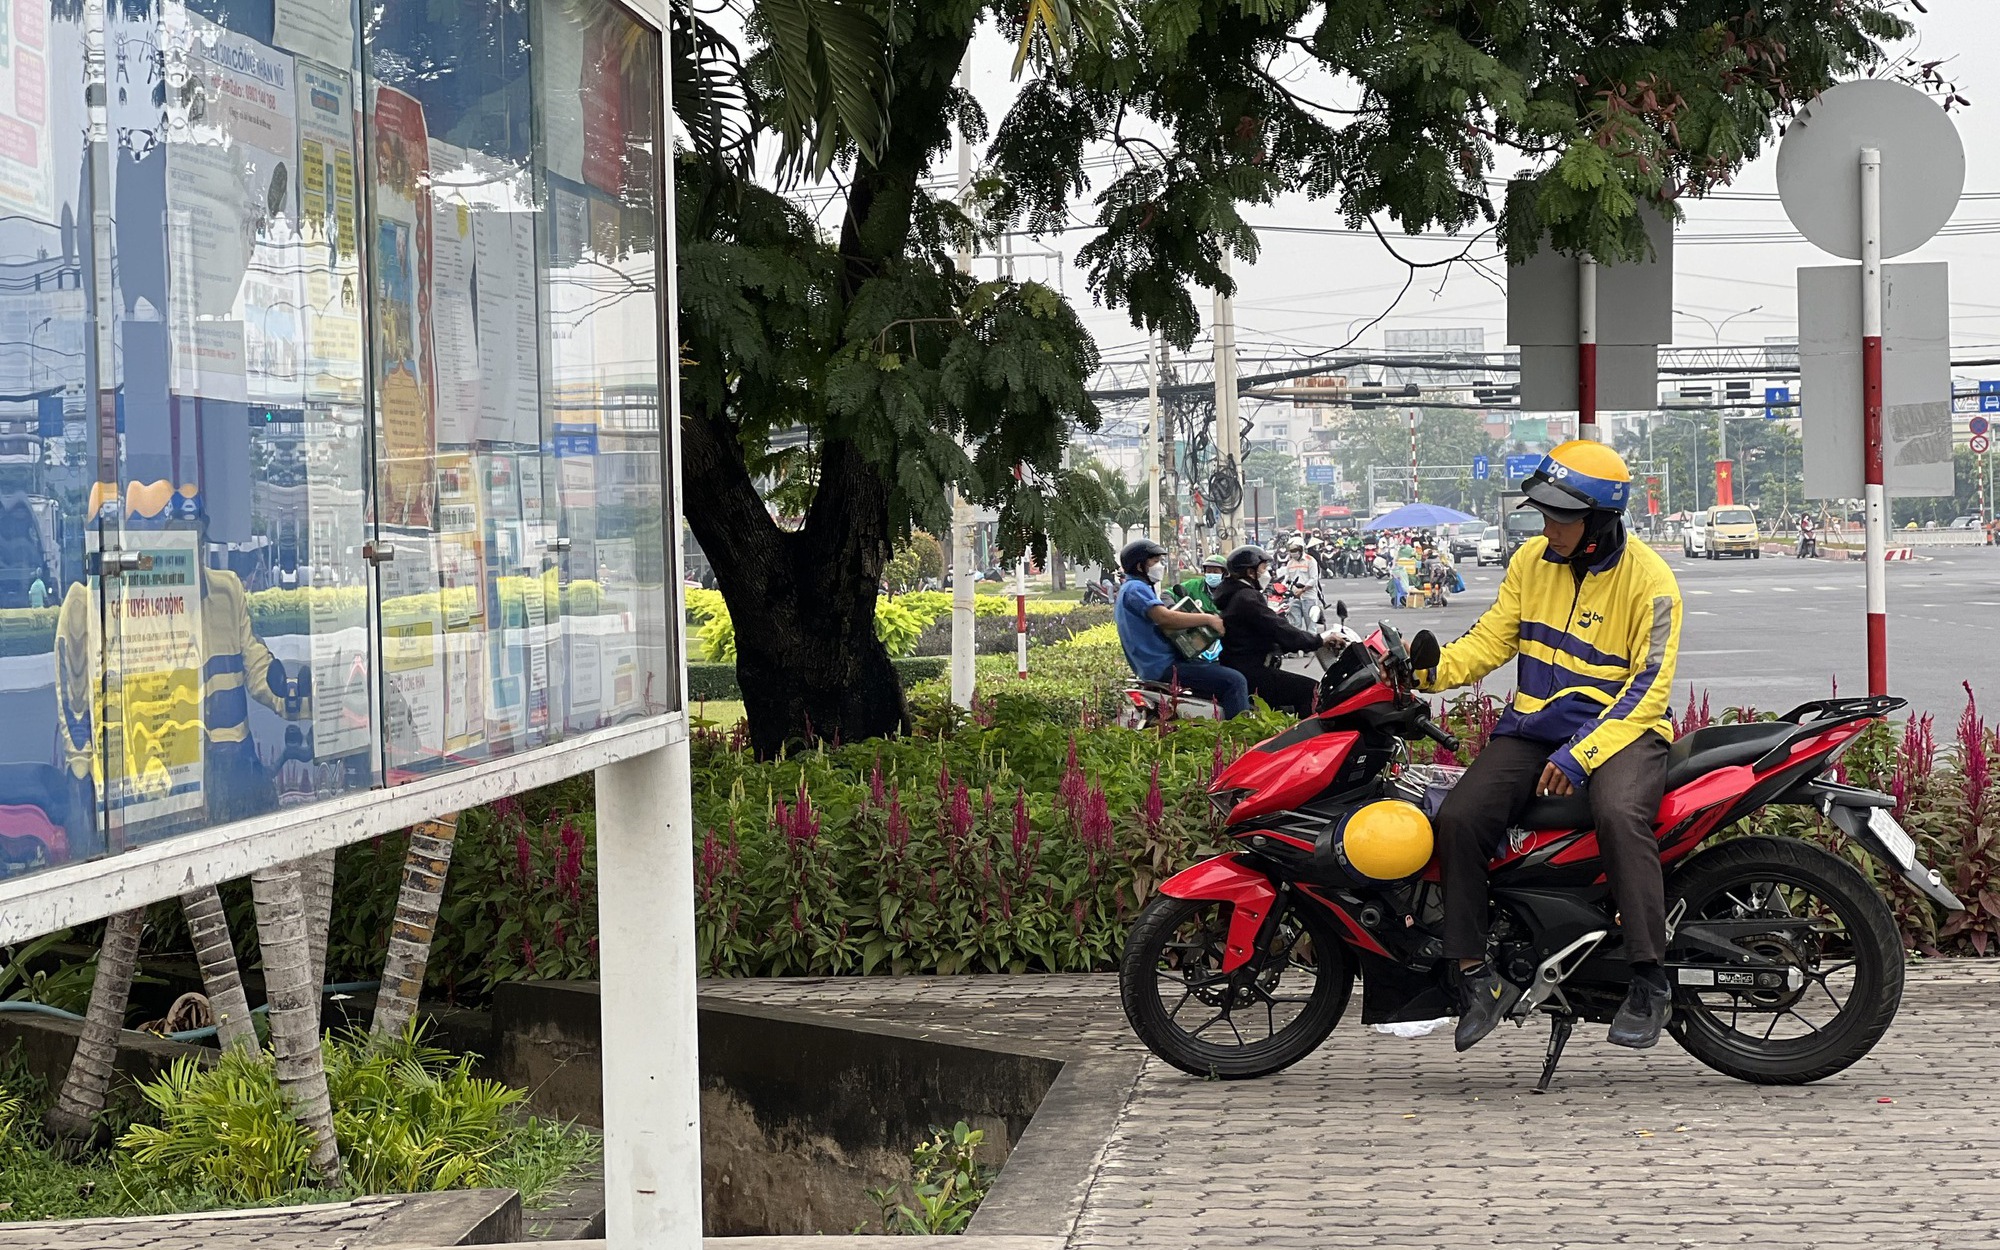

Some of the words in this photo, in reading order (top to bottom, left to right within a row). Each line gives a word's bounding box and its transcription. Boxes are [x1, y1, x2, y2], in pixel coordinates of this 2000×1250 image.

[232, 46, 256, 74] CÔNG
[1547, 460, 1568, 479] be
[126, 590, 150, 619] TUYỂN
[151, 597, 164, 618] LAO
[165, 592, 184, 618] ĐỘNG
[1592, 612, 1603, 623] be
[1584, 746, 1598, 760] be
